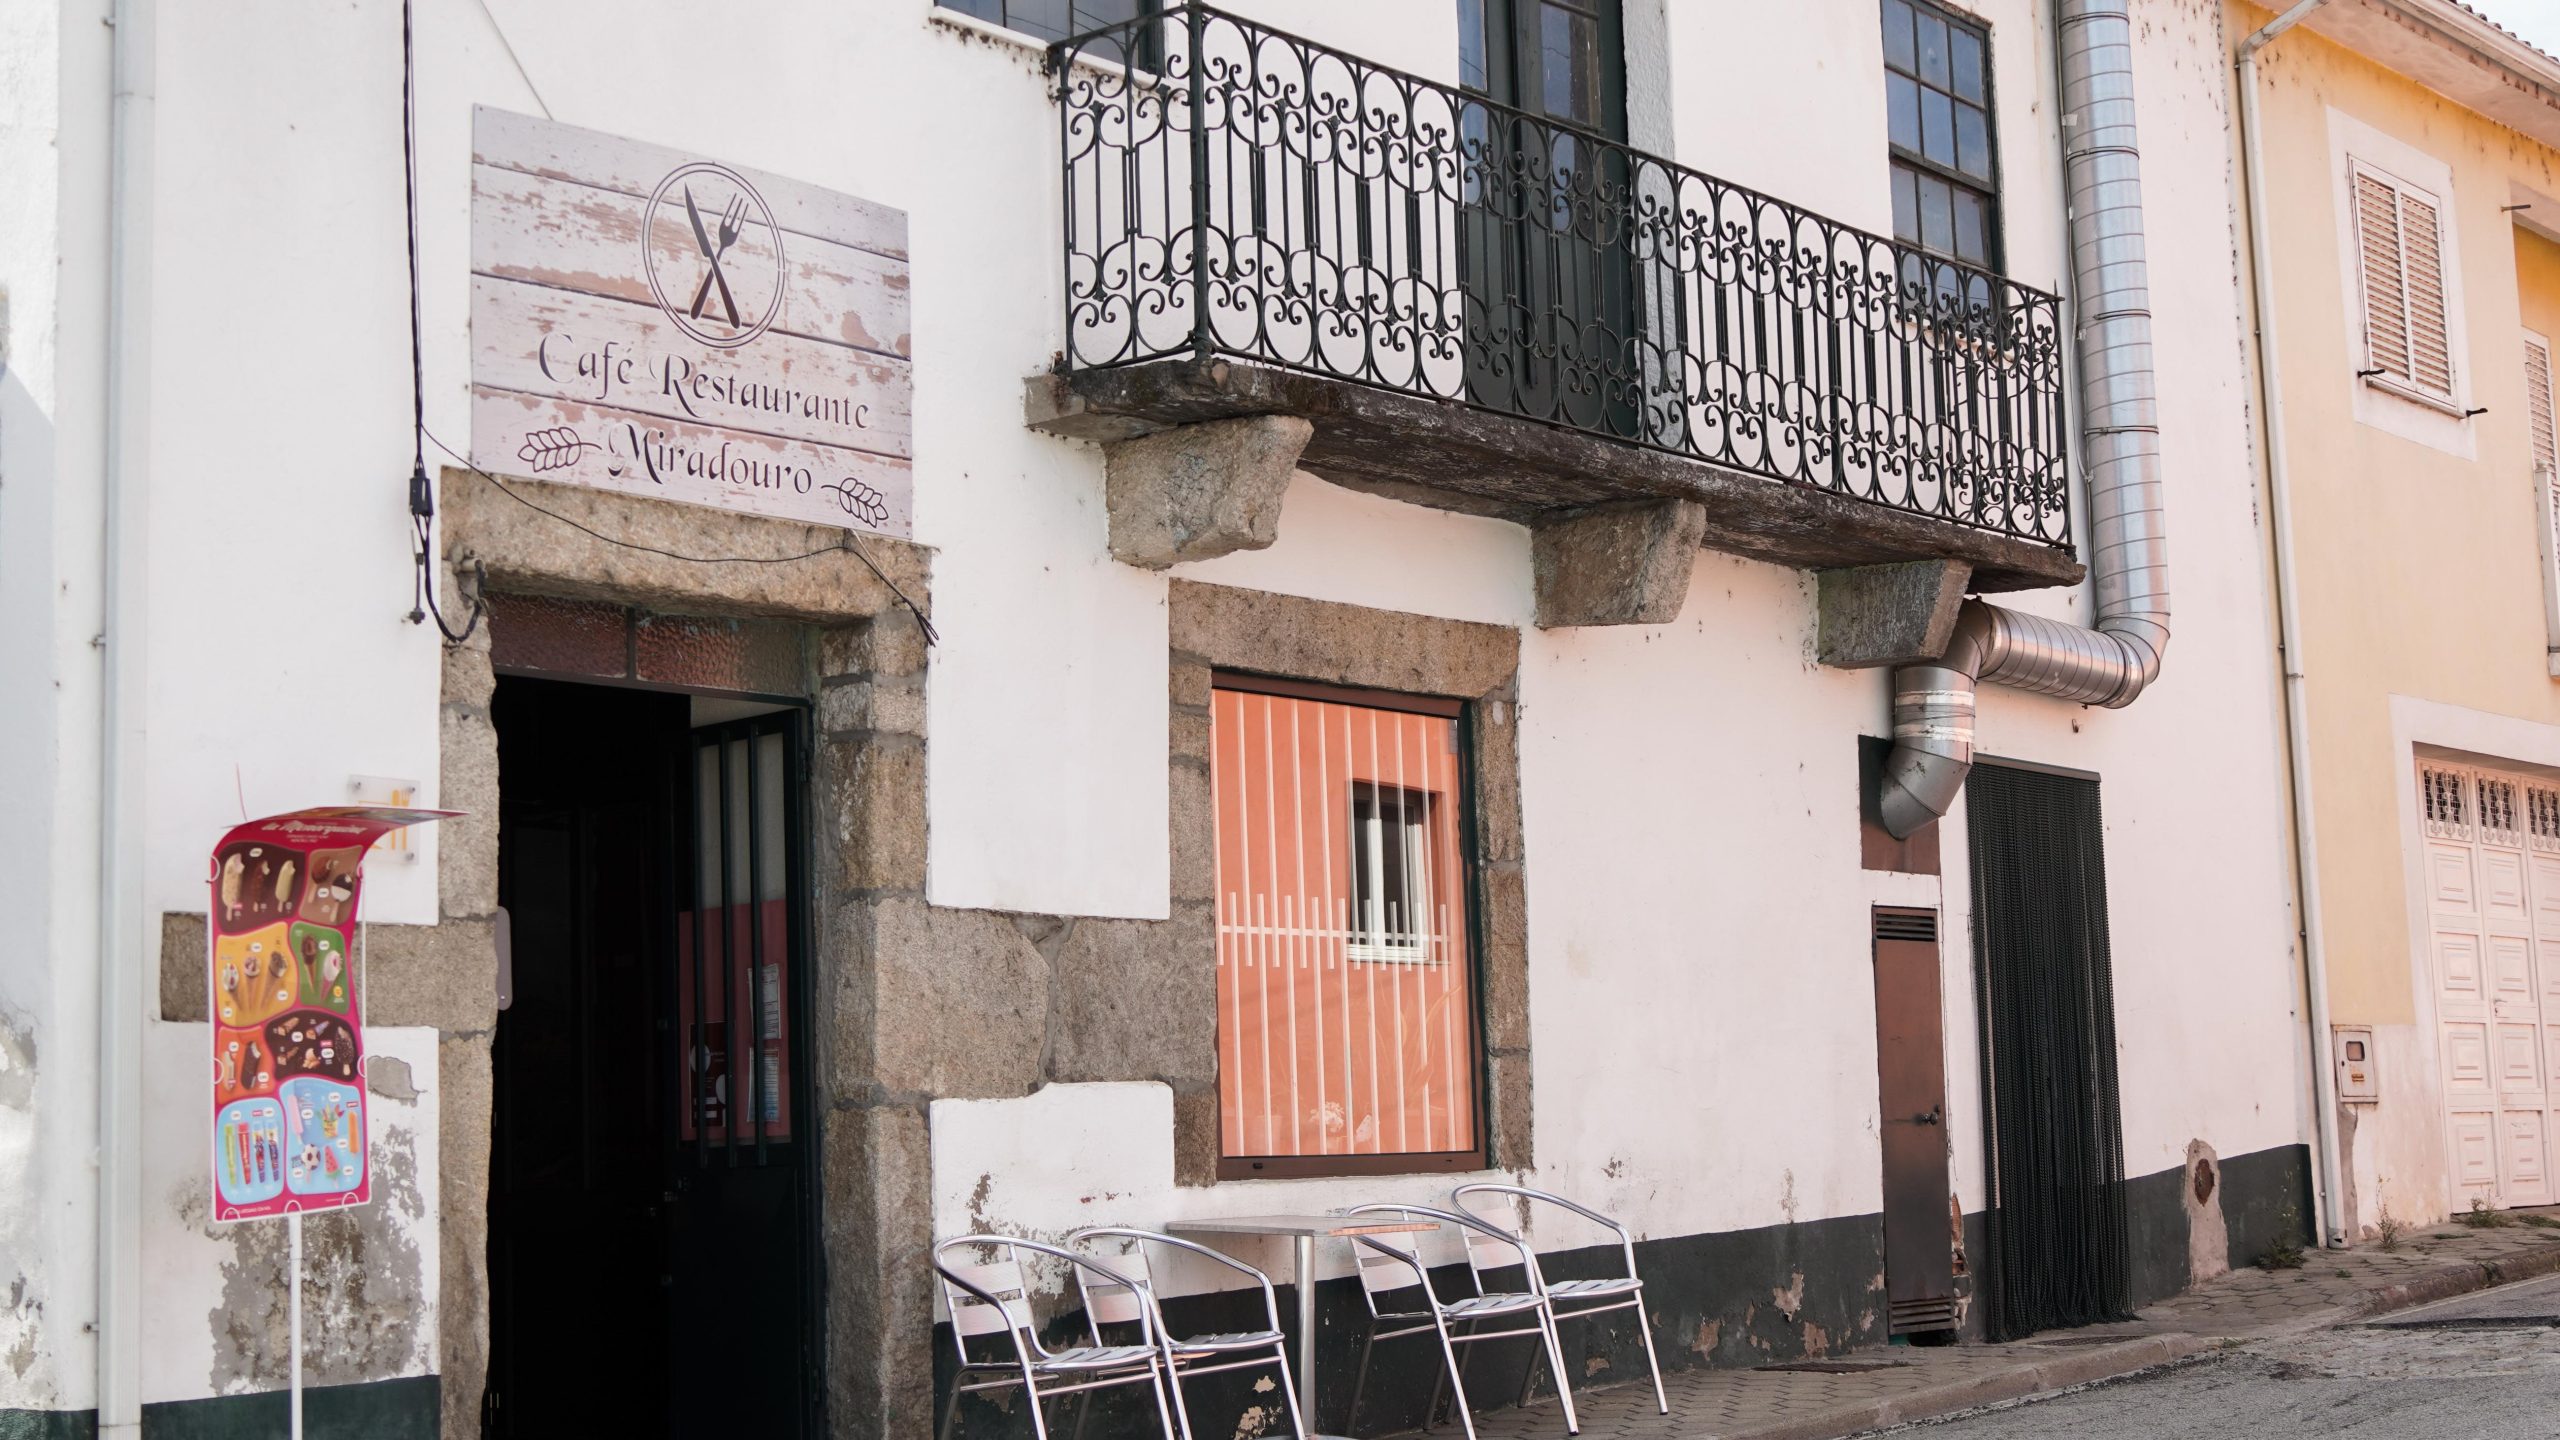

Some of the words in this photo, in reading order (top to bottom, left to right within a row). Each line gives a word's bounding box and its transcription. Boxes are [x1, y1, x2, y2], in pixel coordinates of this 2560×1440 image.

[538, 333, 634, 400] Café
[648, 353, 871, 430] Restaurante
[607, 423, 813, 495] Miradouro
